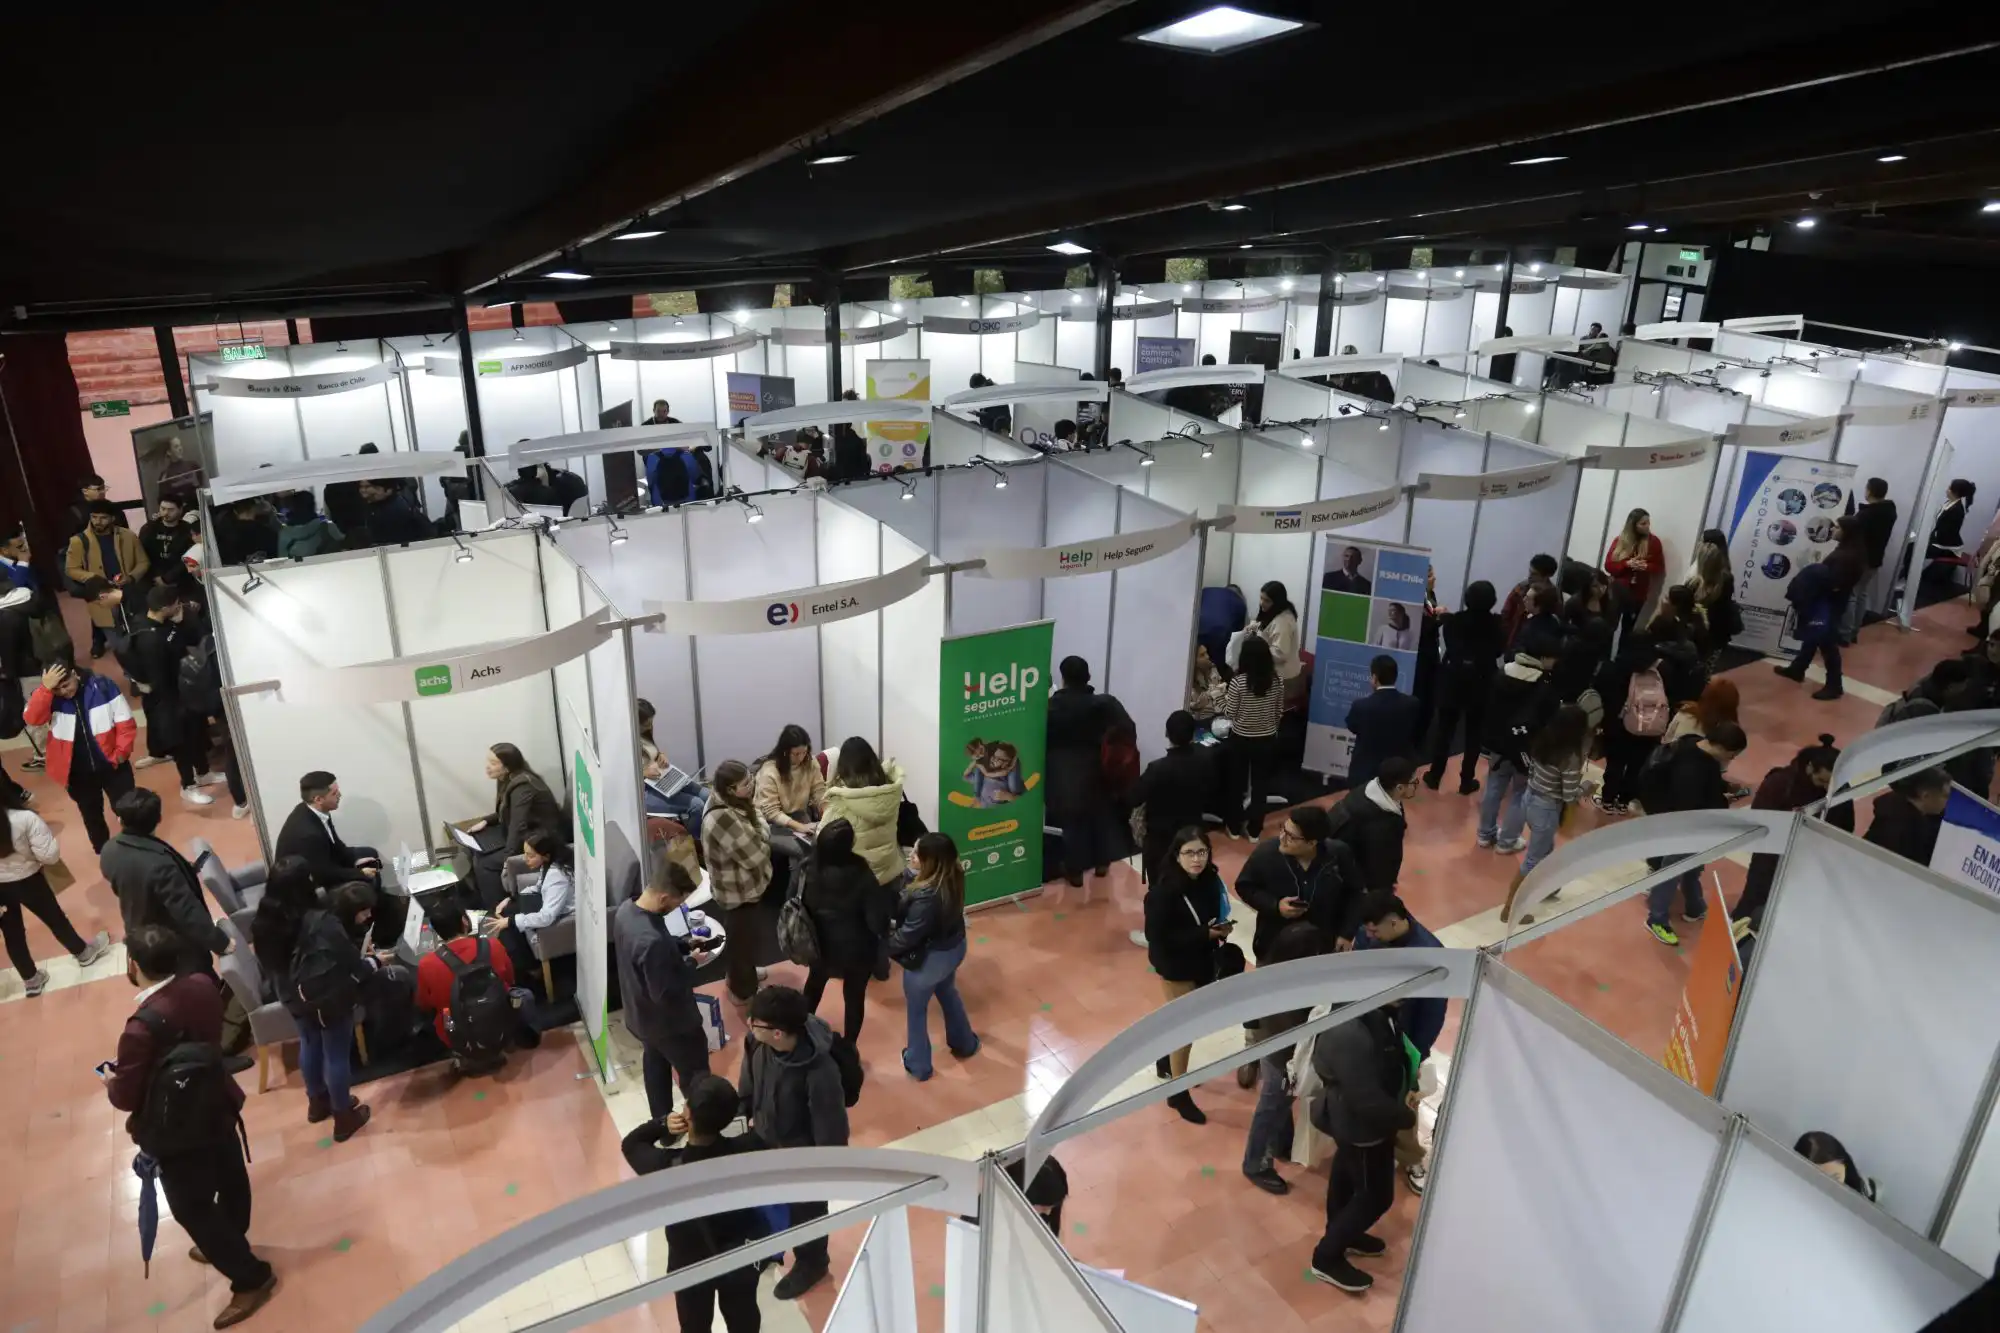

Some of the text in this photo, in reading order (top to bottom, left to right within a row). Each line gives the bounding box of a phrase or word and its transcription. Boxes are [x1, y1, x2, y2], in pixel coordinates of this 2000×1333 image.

[982, 321, 1000, 332] SKC
[223, 345, 263, 361] SALIDA
[511, 360, 553, 371] AFP MODELO
[317, 381, 340, 390] Banco
[349, 376, 366, 385] Chile
[1274, 518, 1301, 529] RSM
[1311, 513, 1330, 523] RSM
[1331, 511, 1349, 521] Chile
[1059, 550, 1093, 567] Help
[1103, 541, 1155, 561] Help Seguros
[1379, 570, 1425, 585] RSM Chile
[812, 597, 860, 615] Entel S.A.
[470, 665, 502, 680] Achs
[419, 675, 449, 687] achs
[963, 662, 1040, 703] Help
[963, 694, 1016, 714] seguros
[1973, 844, 2000, 874] EN M
[1961, 856, 2000, 895] ENCONT
